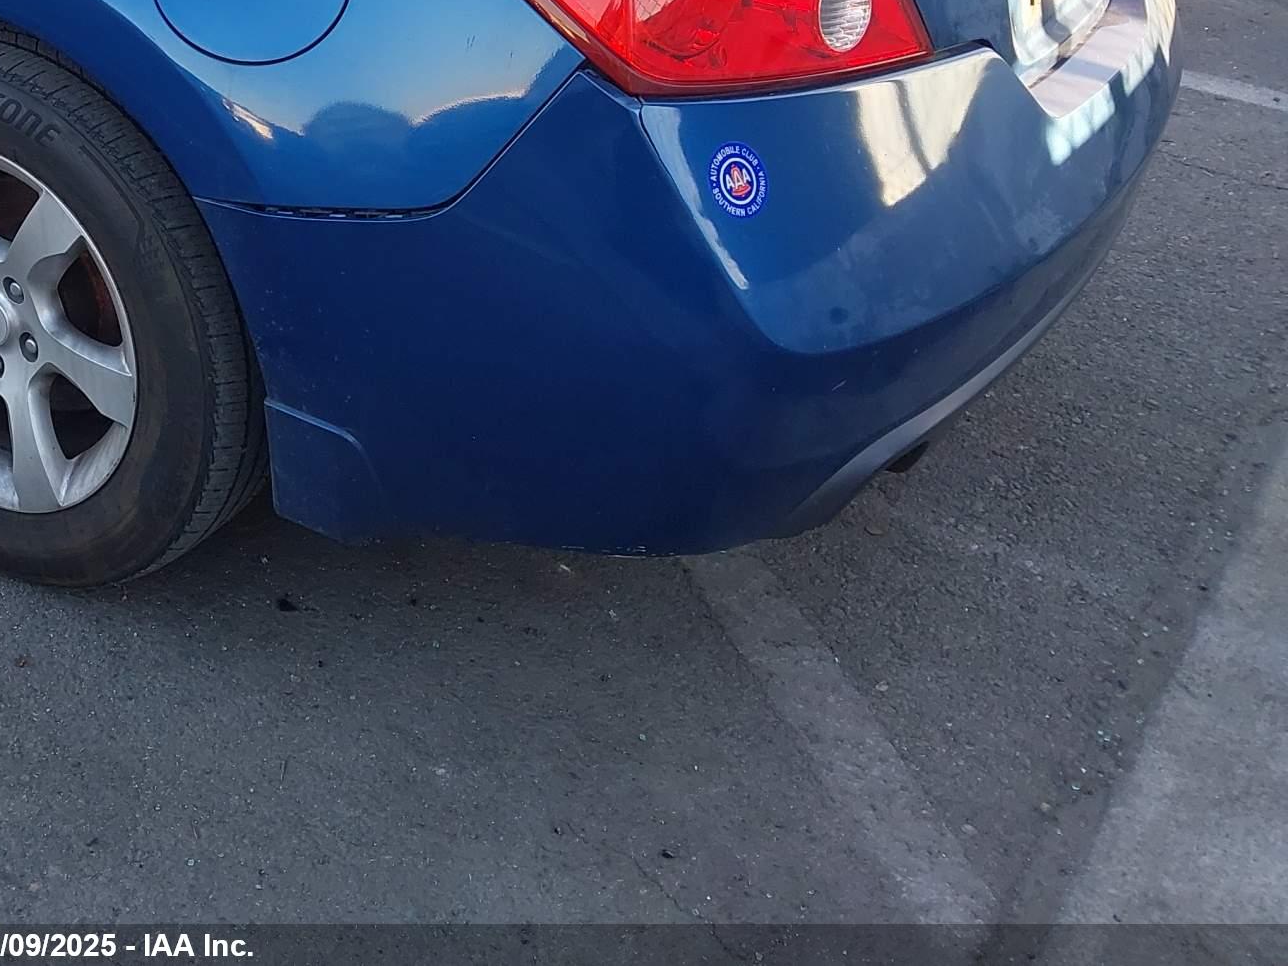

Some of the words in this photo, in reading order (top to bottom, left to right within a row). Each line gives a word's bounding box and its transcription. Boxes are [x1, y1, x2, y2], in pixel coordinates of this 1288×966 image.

[710, 146, 740, 181] AUTOMOBILE
[741, 147, 759, 167] CLUB
[725, 167, 752, 190] AAA
[712, 188, 746, 217] SOUTHERN
[747, 170, 766, 215] CALIFORNIA
